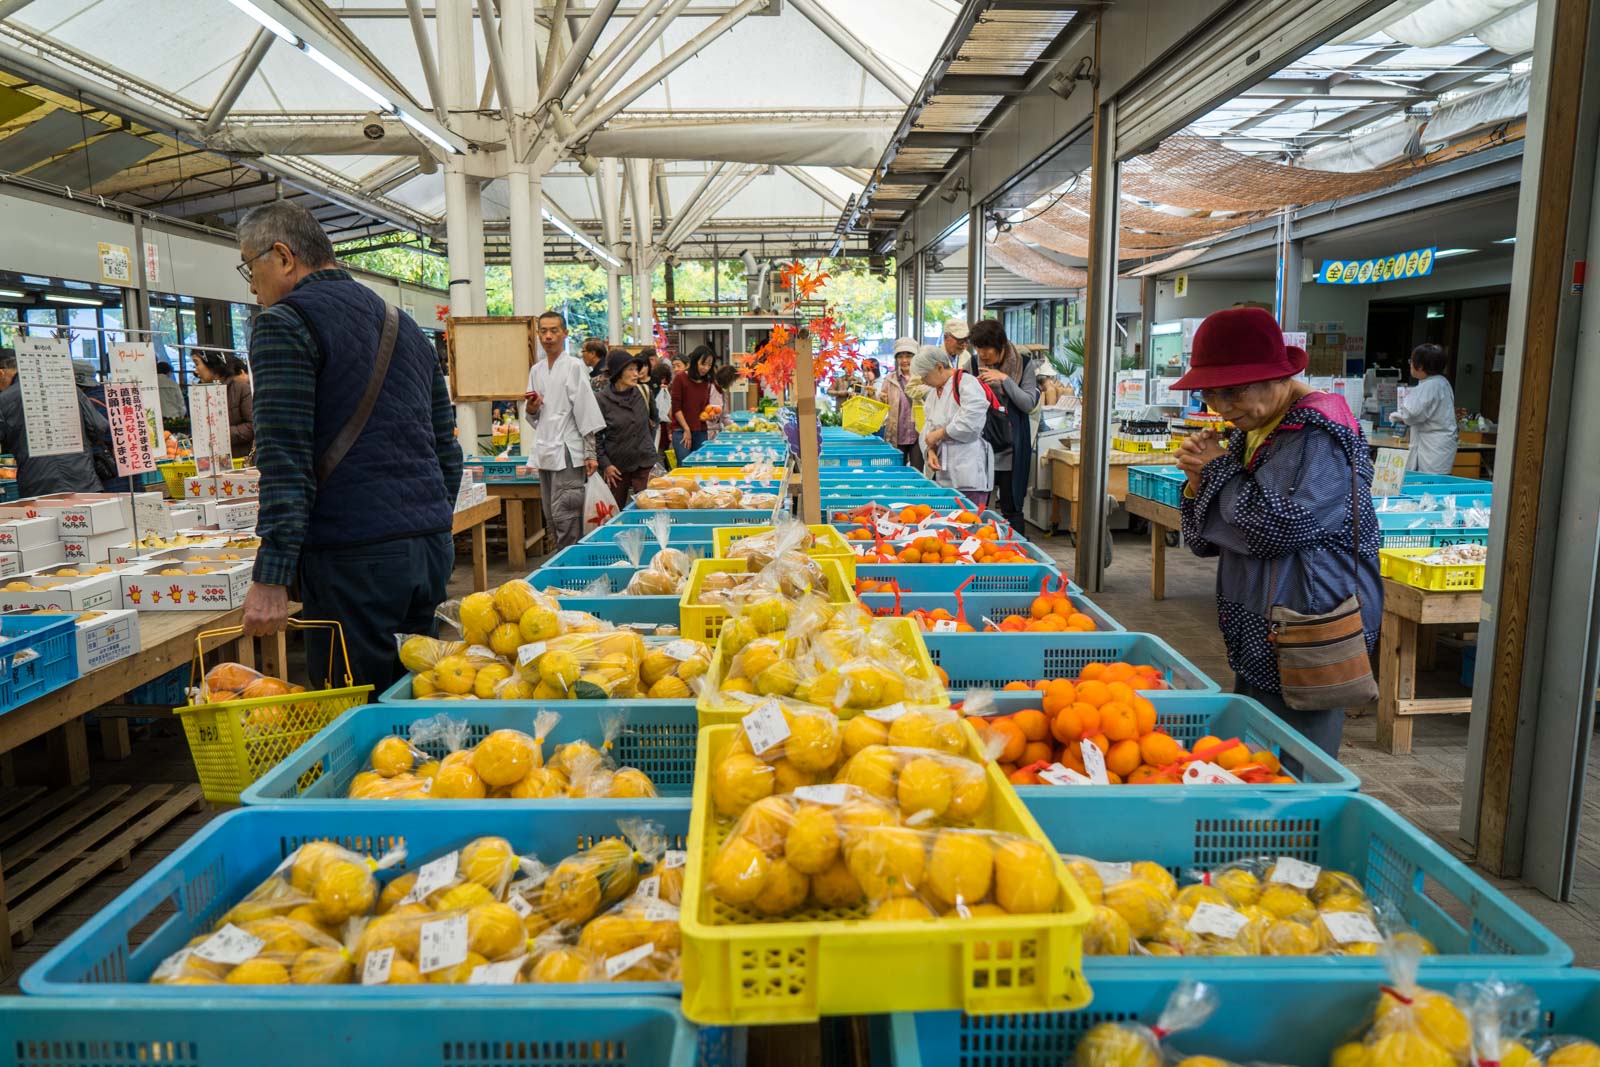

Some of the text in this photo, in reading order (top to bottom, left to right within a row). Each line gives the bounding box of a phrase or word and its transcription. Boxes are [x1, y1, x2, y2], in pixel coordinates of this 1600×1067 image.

[120, 388, 141, 470] 直接触らないように
[131, 387, 152, 469] 商品がいたみますので
[199, 726, 219, 742] からり
